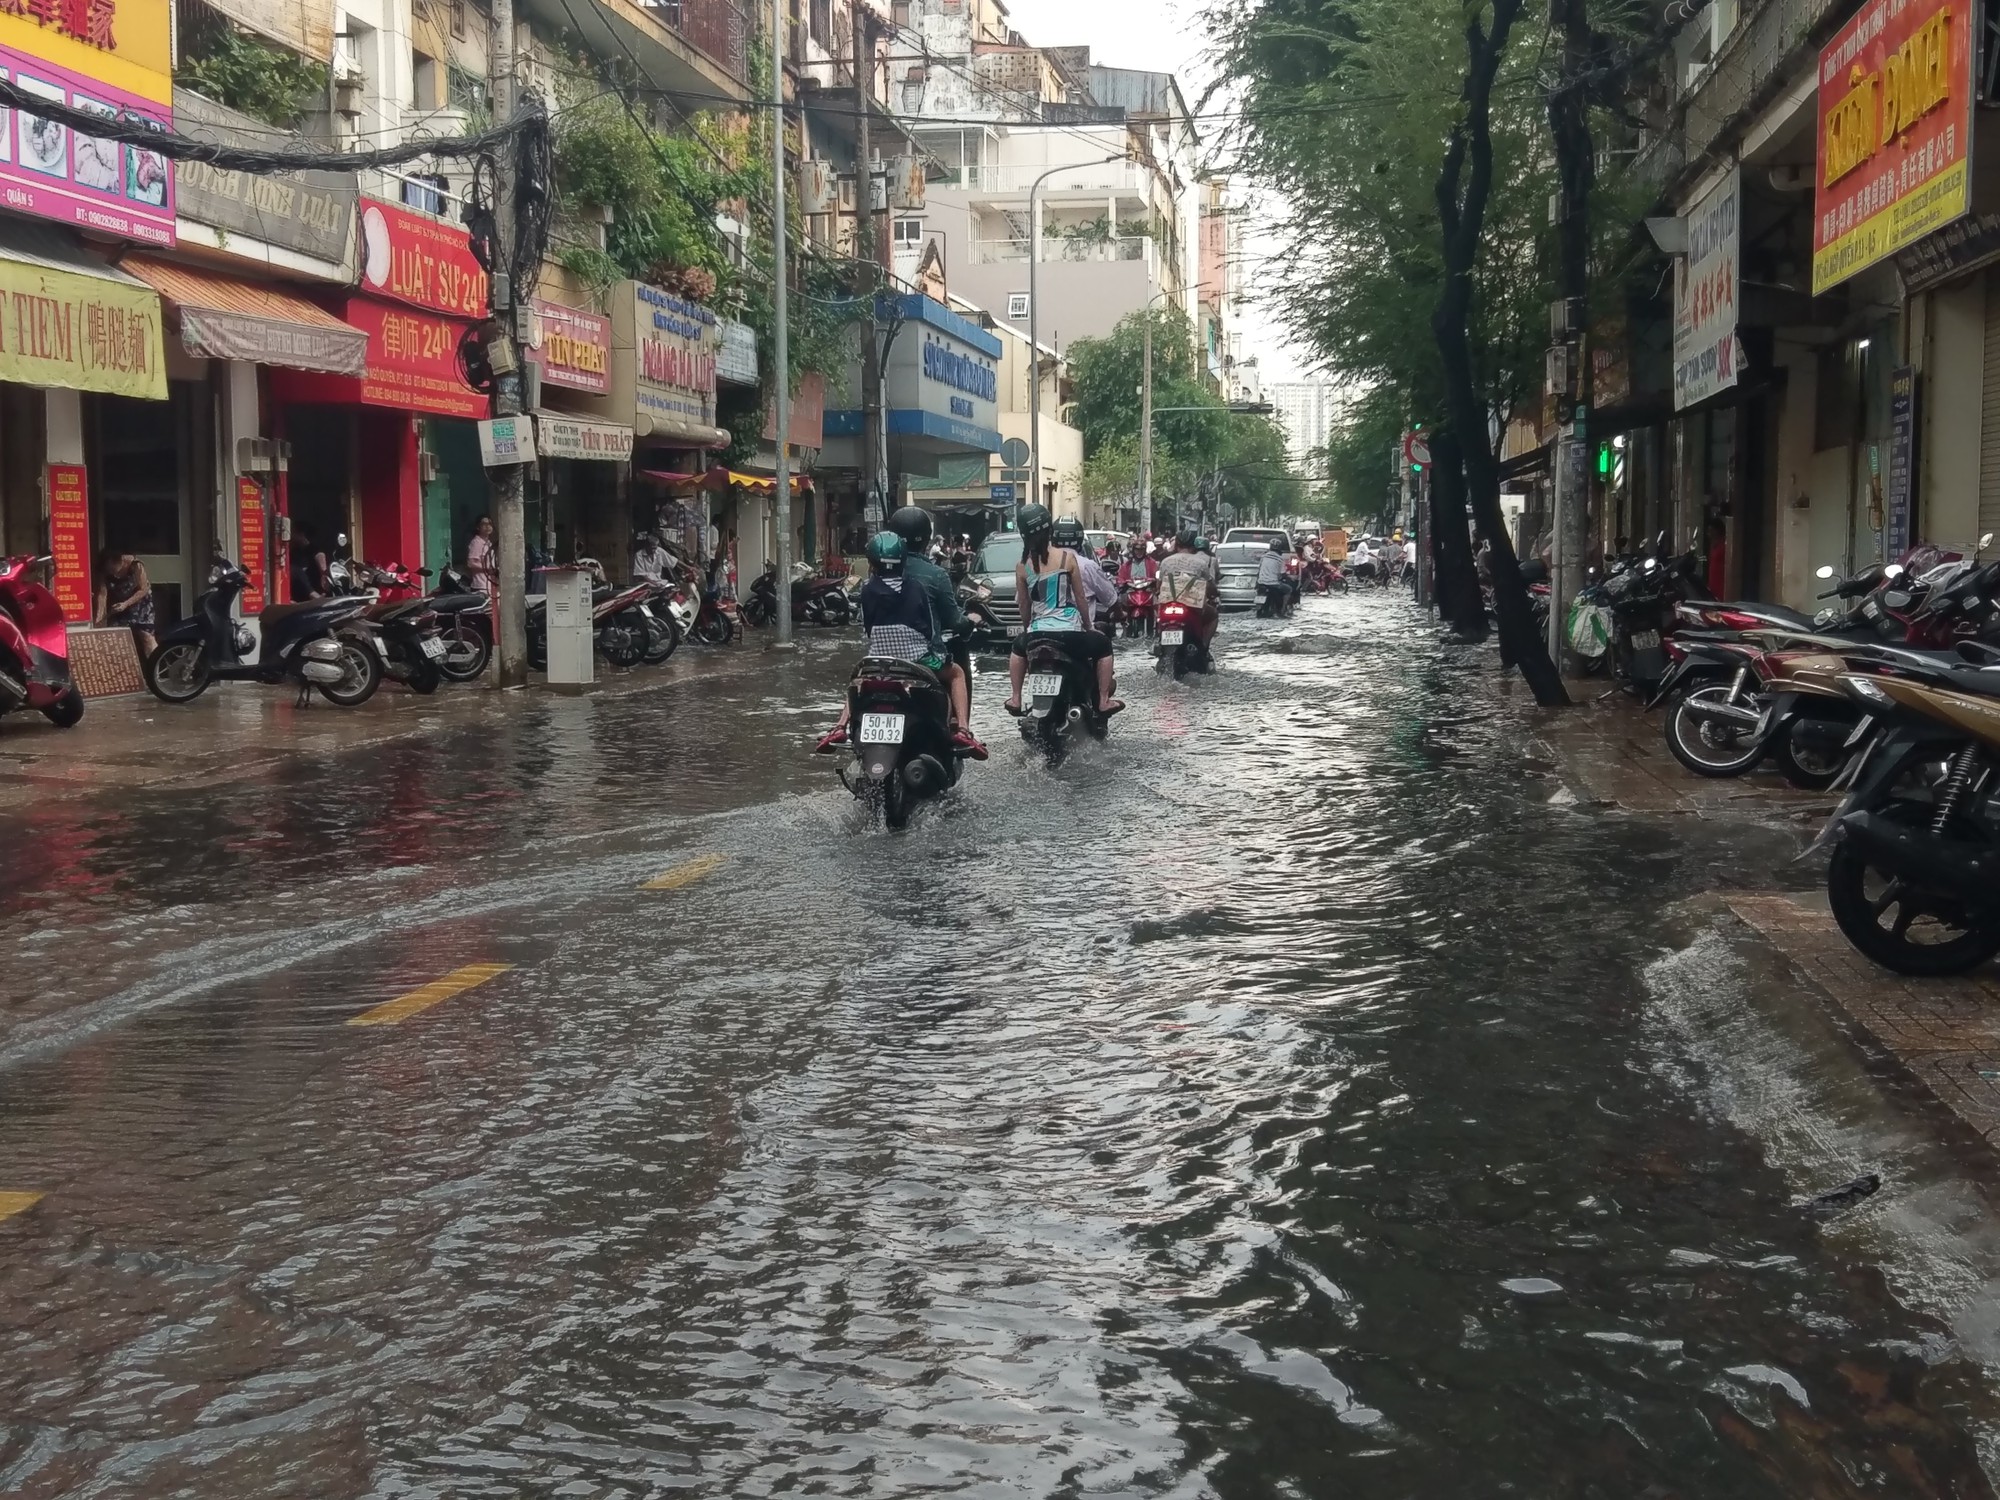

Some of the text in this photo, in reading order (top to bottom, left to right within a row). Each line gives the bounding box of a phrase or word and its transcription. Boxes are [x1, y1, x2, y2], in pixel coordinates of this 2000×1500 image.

[7, 188, 34, 206] QUẬN 5
[392, 243, 434, 302] LUẬT
[382, 311, 419, 363] 律师
[1031, 684, 1055, 694] 5520
[868, 716, 897, 729] 50-N1
[863, 728, 900, 741] 590.32
